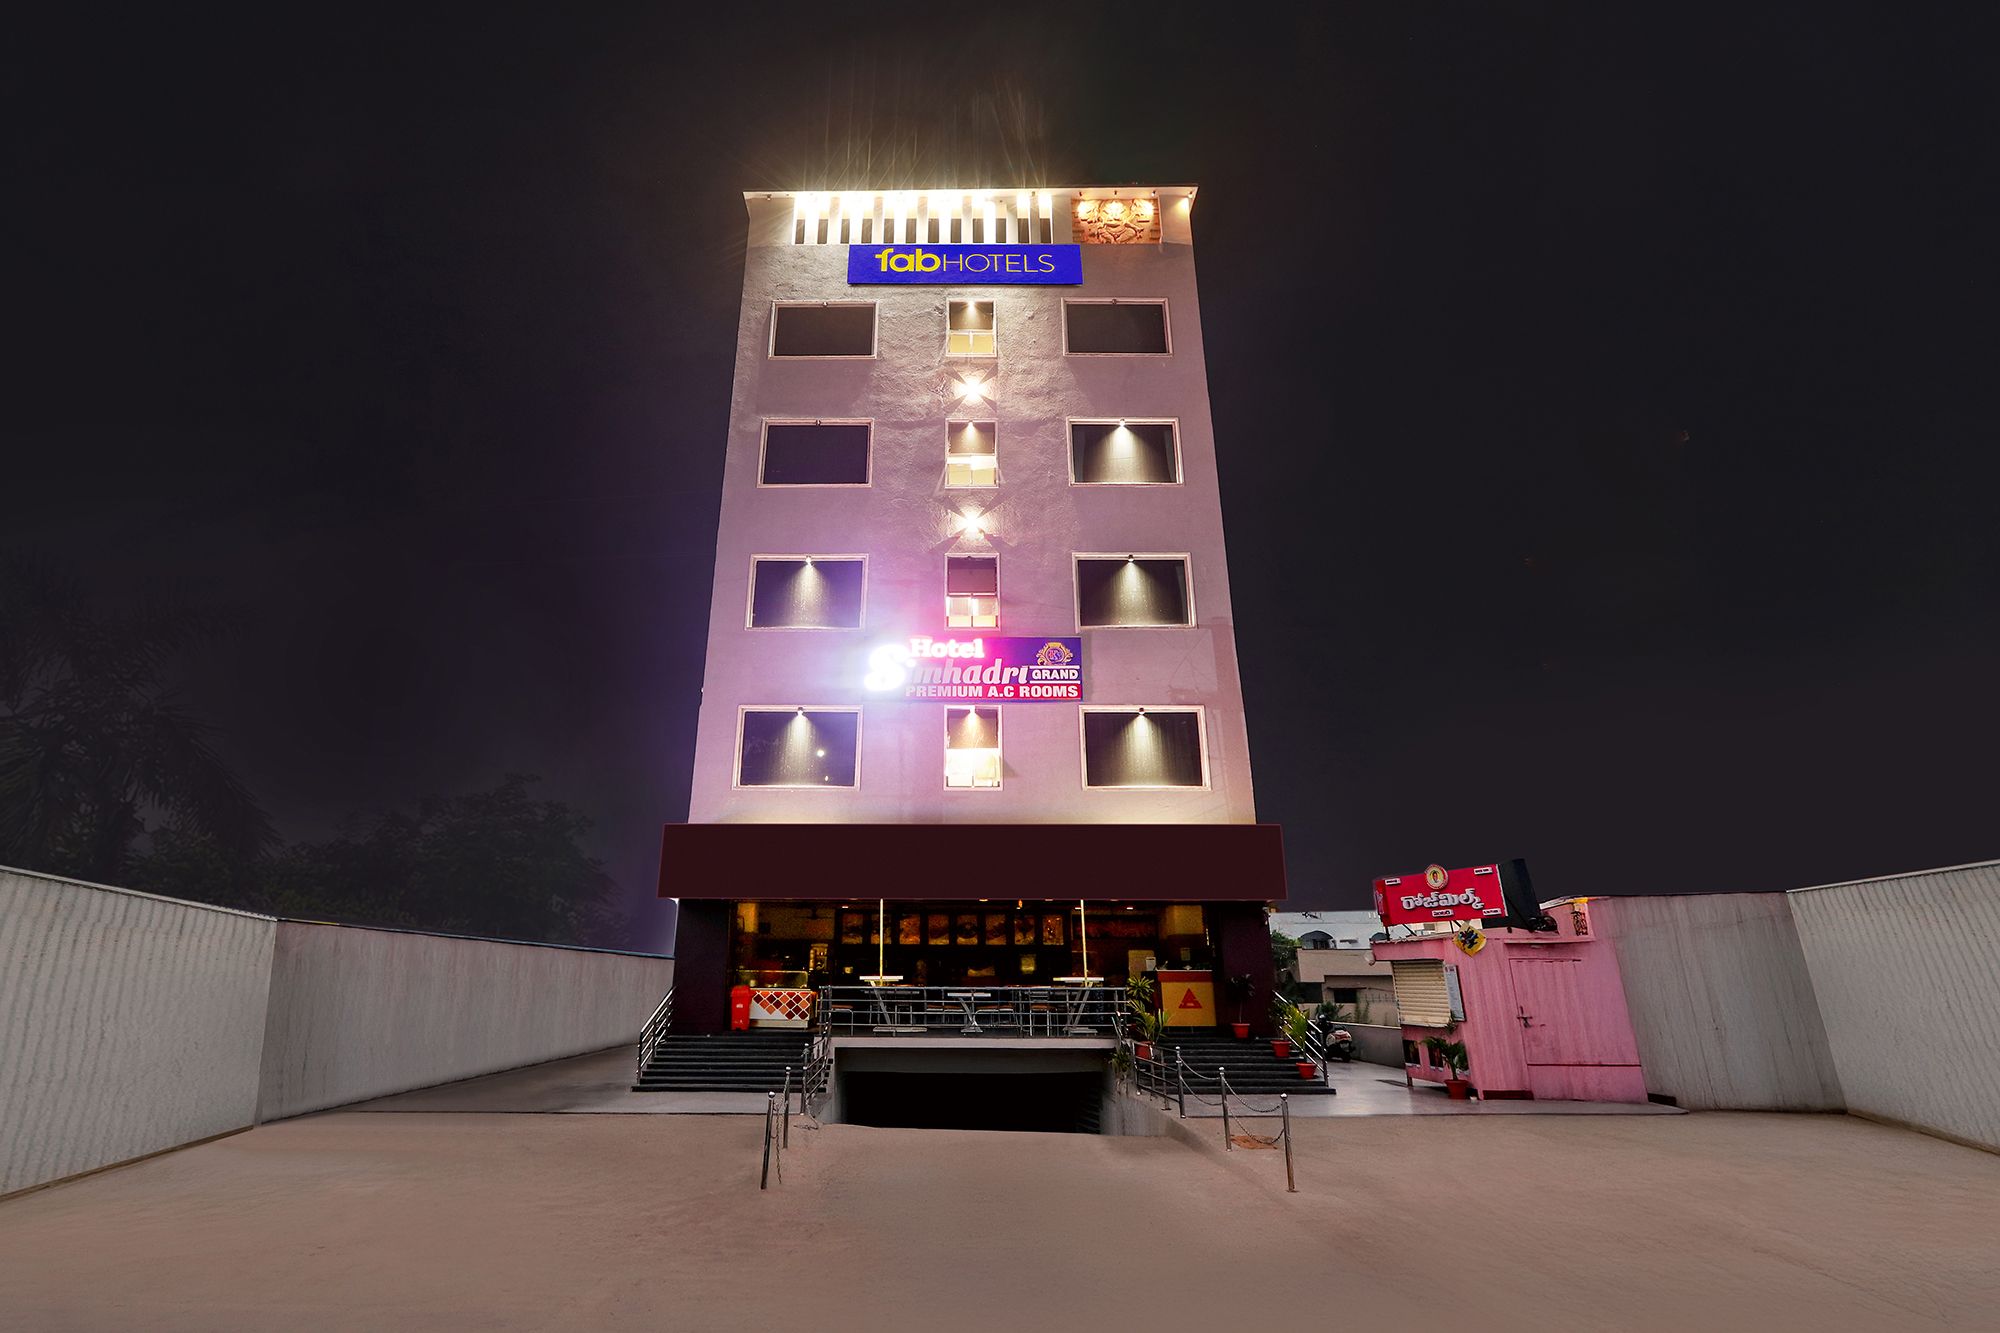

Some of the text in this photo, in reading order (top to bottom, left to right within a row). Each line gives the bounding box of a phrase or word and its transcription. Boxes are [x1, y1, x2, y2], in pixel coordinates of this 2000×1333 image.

[908, 638, 985, 658] Hotel
[864, 643, 1030, 691] Simhadri
[1032, 669, 1079, 680] GRAND
[905, 684, 1079, 698] PREMIUM A.C ROOMS
